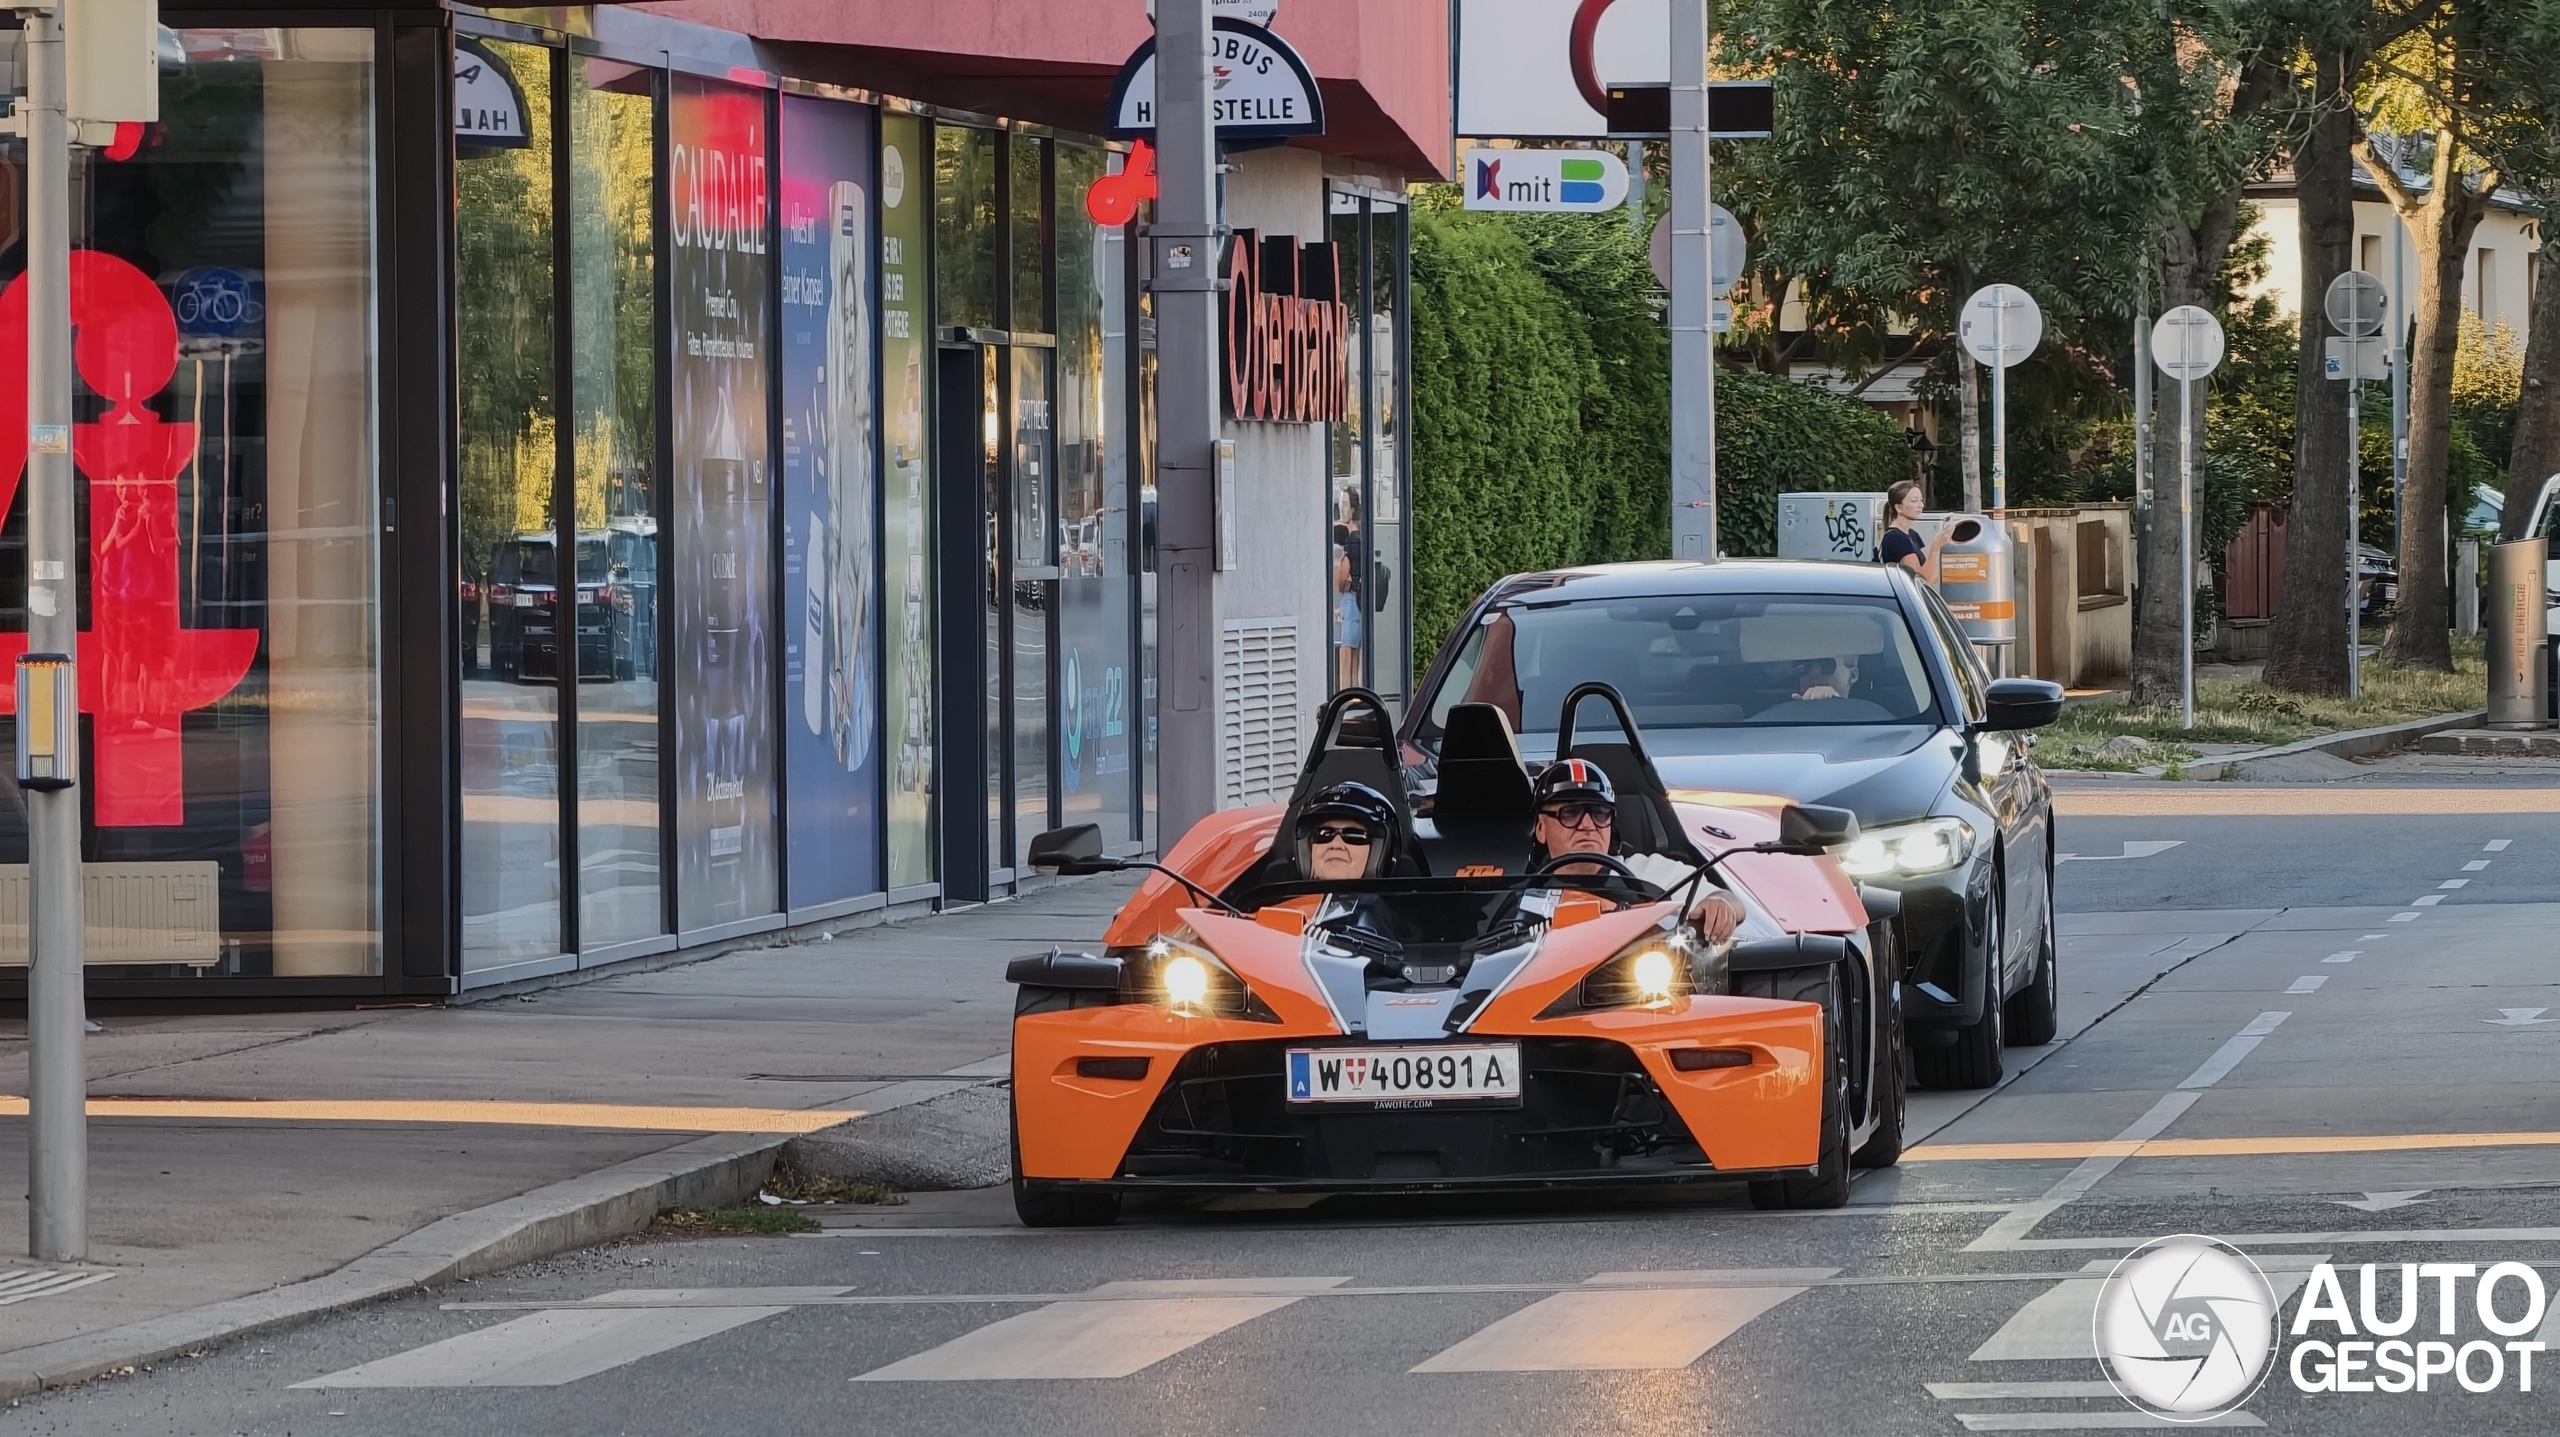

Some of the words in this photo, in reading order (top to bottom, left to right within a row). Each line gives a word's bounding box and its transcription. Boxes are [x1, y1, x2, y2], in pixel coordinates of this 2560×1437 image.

[1509, 176, 1551, 202] mit
[1229, 228, 1348, 422] Oberbank
[1318, 1058, 1341, 1092] W
